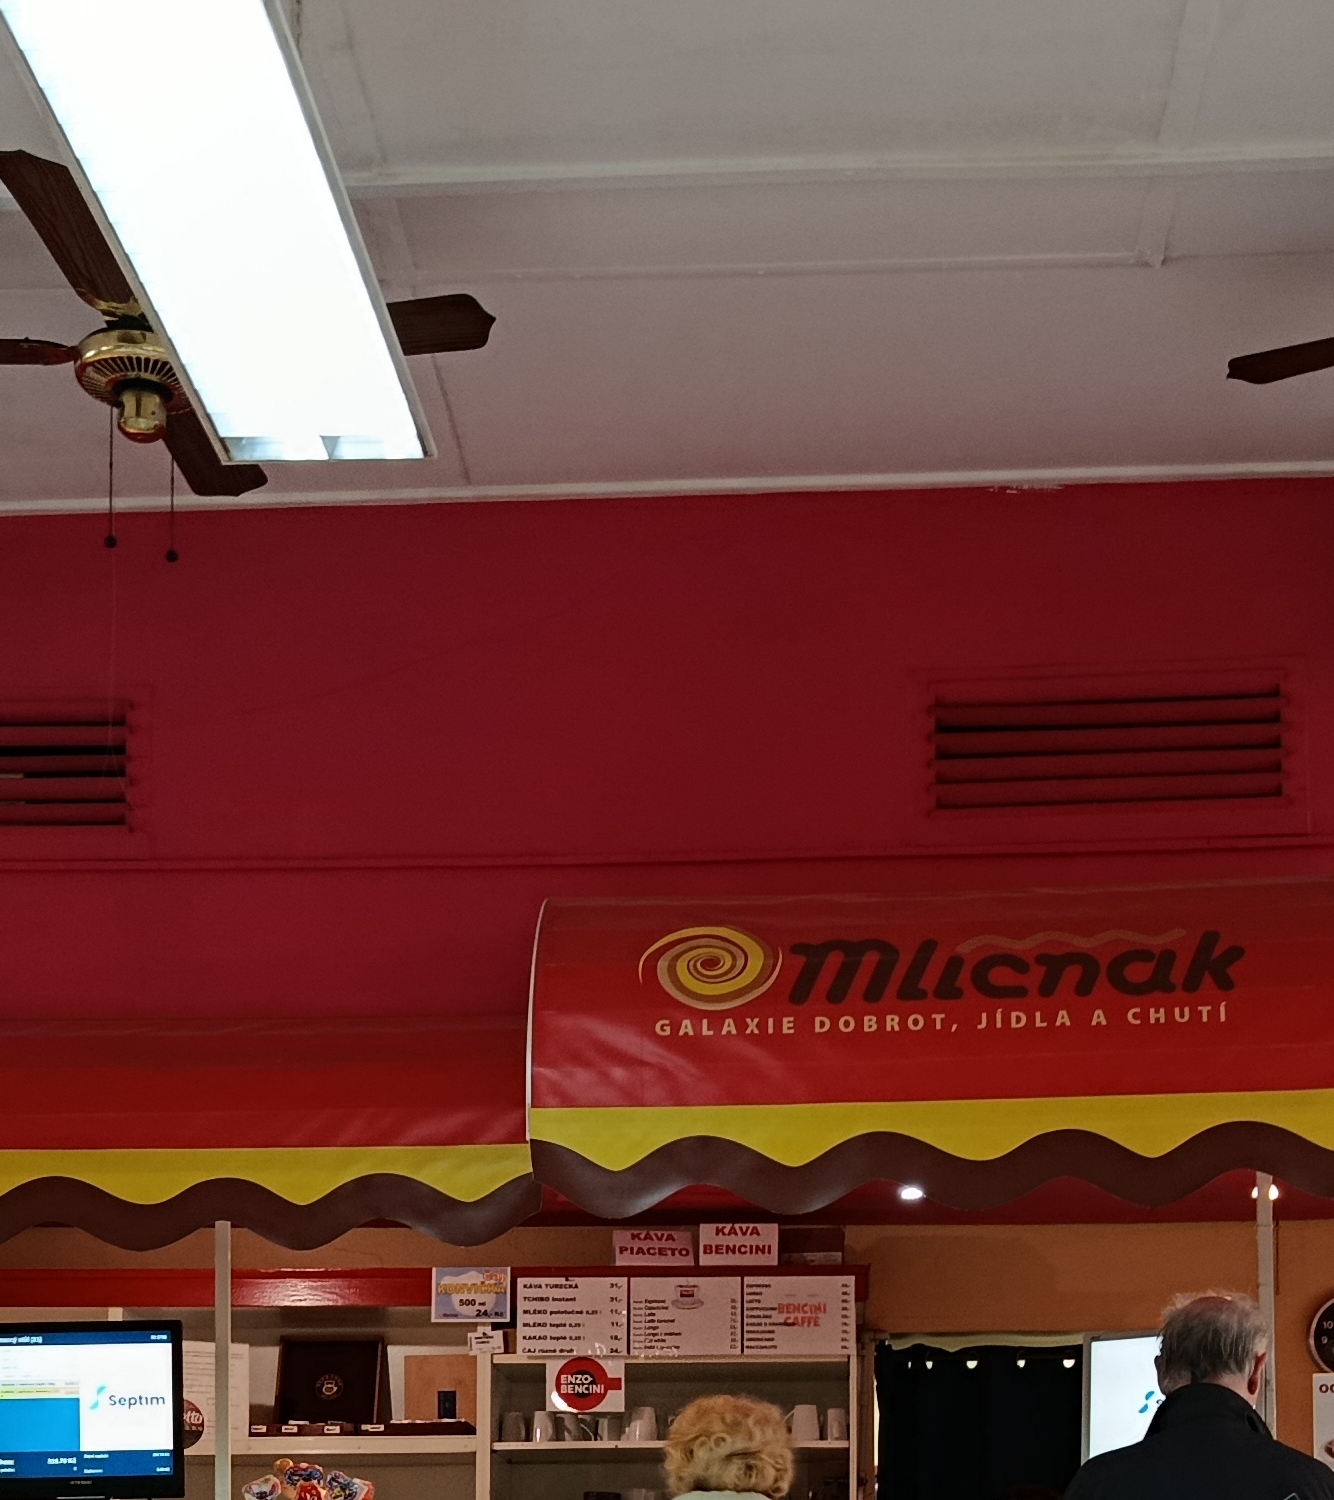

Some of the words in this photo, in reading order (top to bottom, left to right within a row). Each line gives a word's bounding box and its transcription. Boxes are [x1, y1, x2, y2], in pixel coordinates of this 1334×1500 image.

[655, 1016, 796, 1036] GALAXIE
[814, 1012, 958, 1034] DOBROT,
[977, 1008, 1071, 1030] JÍDLA
[1091, 1008, 1107, 1026] A
[1127, 1000, 1226, 1025] CHUTÍ
[715, 1223, 761, 1236] KÁVA
[631, 1230, 676, 1242] KÁVA
[619, 1246, 690, 1257] PIACETO
[703, 1244, 772, 1255] BENCINI
[777, 1303, 827, 1314] BENCINI
[1324, 1321, 1334, 1329] 10
[560, 1374, 593, 1384] ENZO
[560, 1384, 604, 1394] BENCINI
